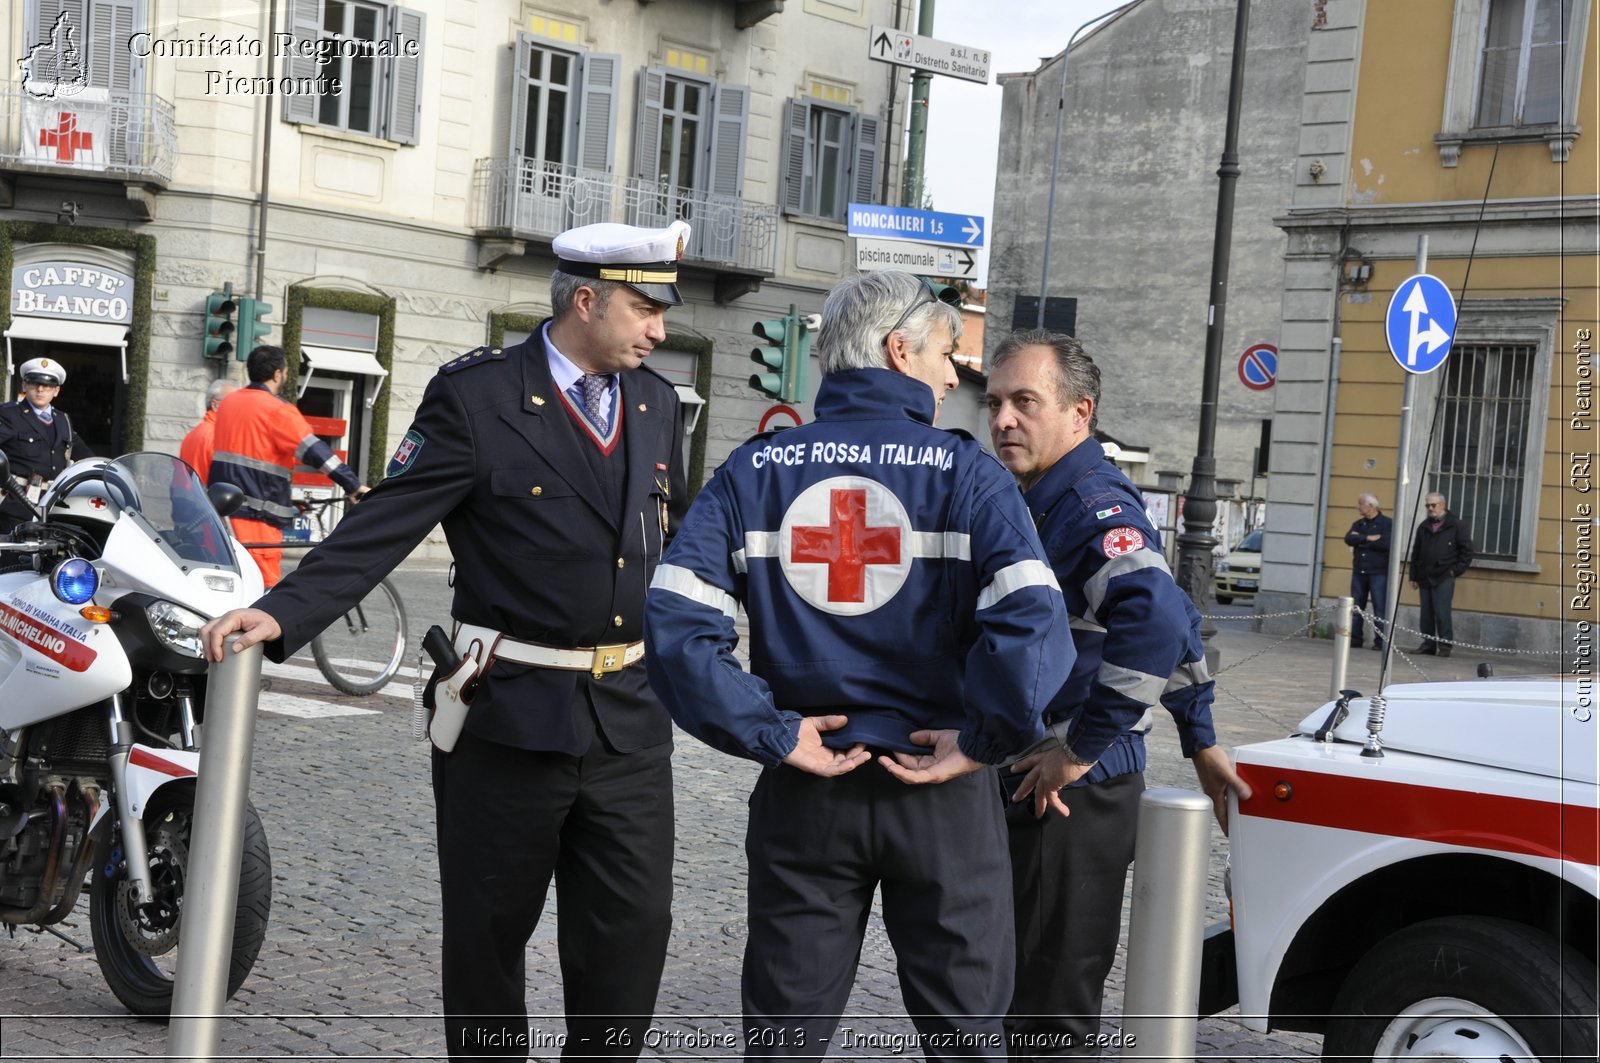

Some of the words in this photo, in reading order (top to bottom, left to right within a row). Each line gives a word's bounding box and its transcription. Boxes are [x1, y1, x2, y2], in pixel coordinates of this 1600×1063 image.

[915, 52, 949, 70] Distretto
[951, 61, 986, 78] Sanitario
[950, 47, 968, 60] a.s.l.
[973, 54, 980, 63] n.
[982, 53, 988, 64] 8
[853, 211, 924, 233] MONCALIERI
[930, 218, 944, 235] 1,5
[859, 246, 891, 265] piscina
[893, 251, 934, 267] comunale
[23, 267, 125, 295] CAFFE'
[16, 289, 128, 320] BLANCO
[752, 443, 806, 469] CROCE
[811, 441, 871, 464] ROSSA
[879, 443, 954, 472] ITALIANA
[11, 597, 26, 610] DONO
[24, 603, 32, 613] DI
[32, 607, 60, 628] YAMAHA
[60, 622, 87, 643] ITALIA
